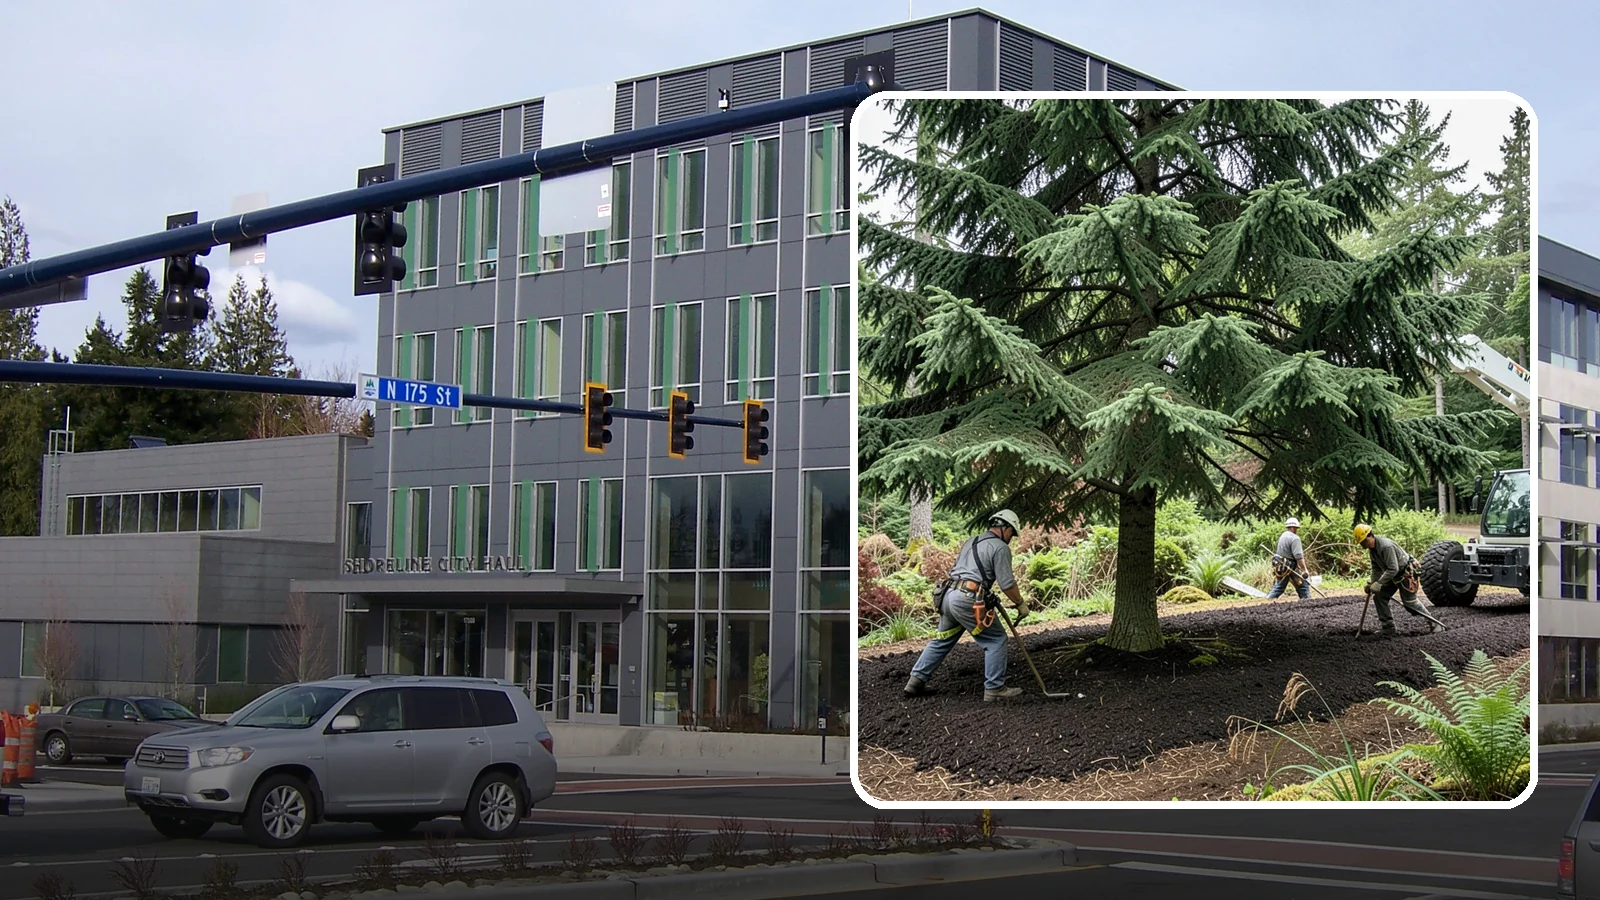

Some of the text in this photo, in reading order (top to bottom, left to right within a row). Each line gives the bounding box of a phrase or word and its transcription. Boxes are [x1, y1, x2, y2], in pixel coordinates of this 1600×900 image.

[387, 380, 451, 406] N 175 St
[344, 555, 526, 574] SHORELINE CITY HALL
